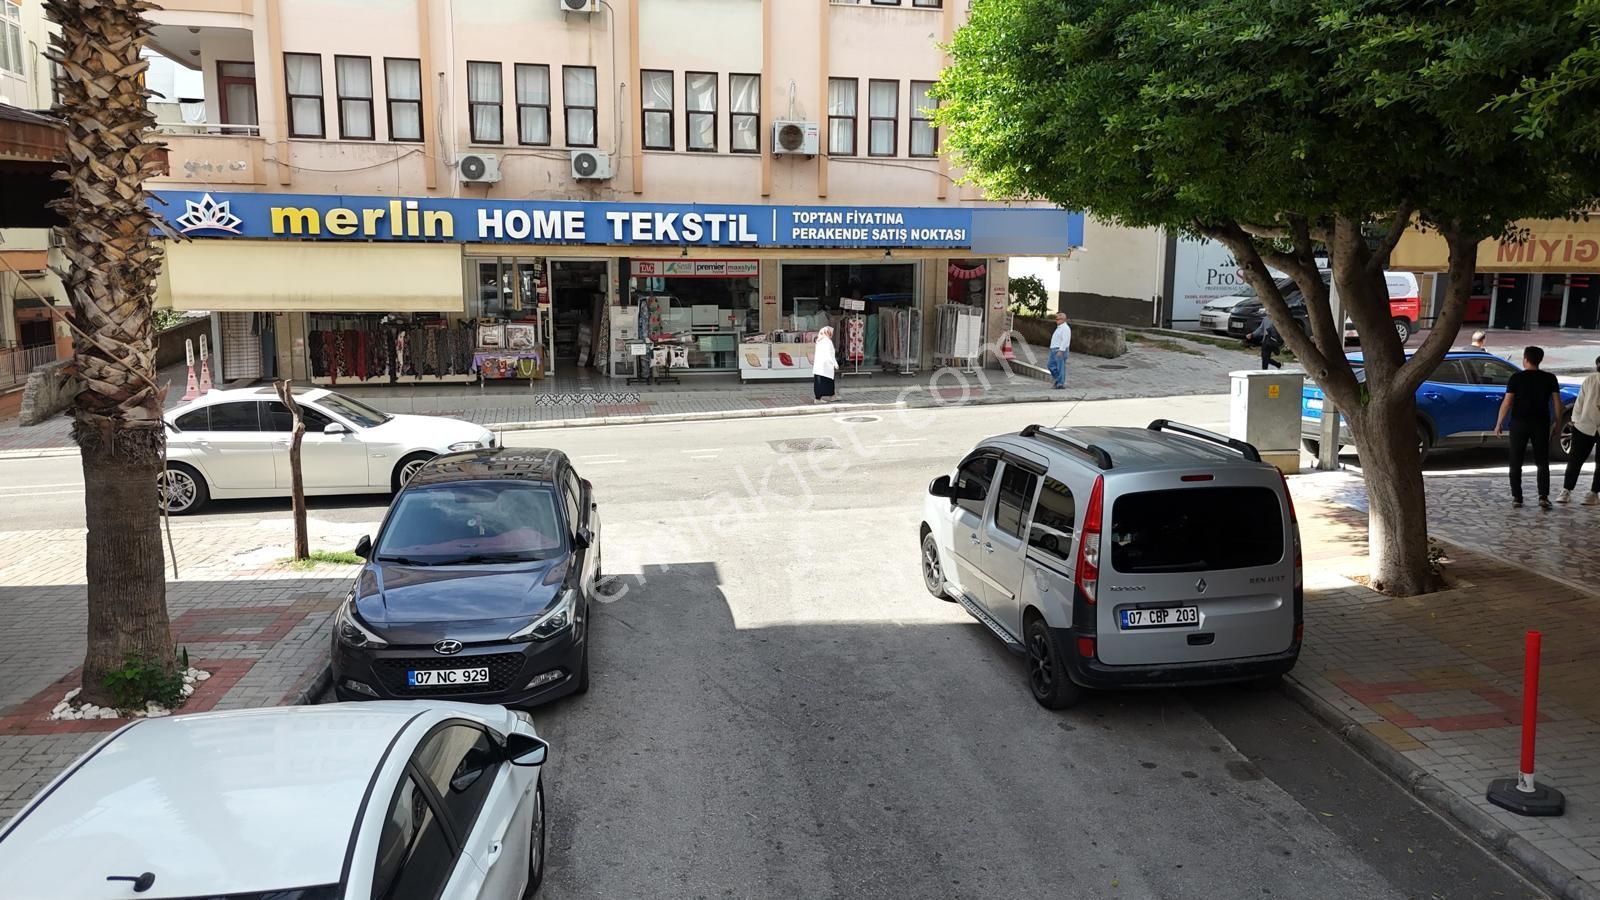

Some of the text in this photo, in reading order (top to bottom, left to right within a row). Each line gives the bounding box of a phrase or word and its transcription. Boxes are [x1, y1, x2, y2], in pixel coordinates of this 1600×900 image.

[270, 200, 454, 238] merlin
[478, 208, 586, 240] HOME
[792, 209, 904, 225] TOPTAN FİYATINA
[792, 228, 966, 244] PERAKENDE SATIŞ NOKTASI
[696, 262, 725, 272] premier
[1129, 611, 1142, 624] 07
[1149, 610, 1169, 623] CBP
[1176, 609, 1196, 622] 203
[416, 672, 431, 684] 07
[437, 671, 457, 683] NC
[462, 669, 488, 682] 929
